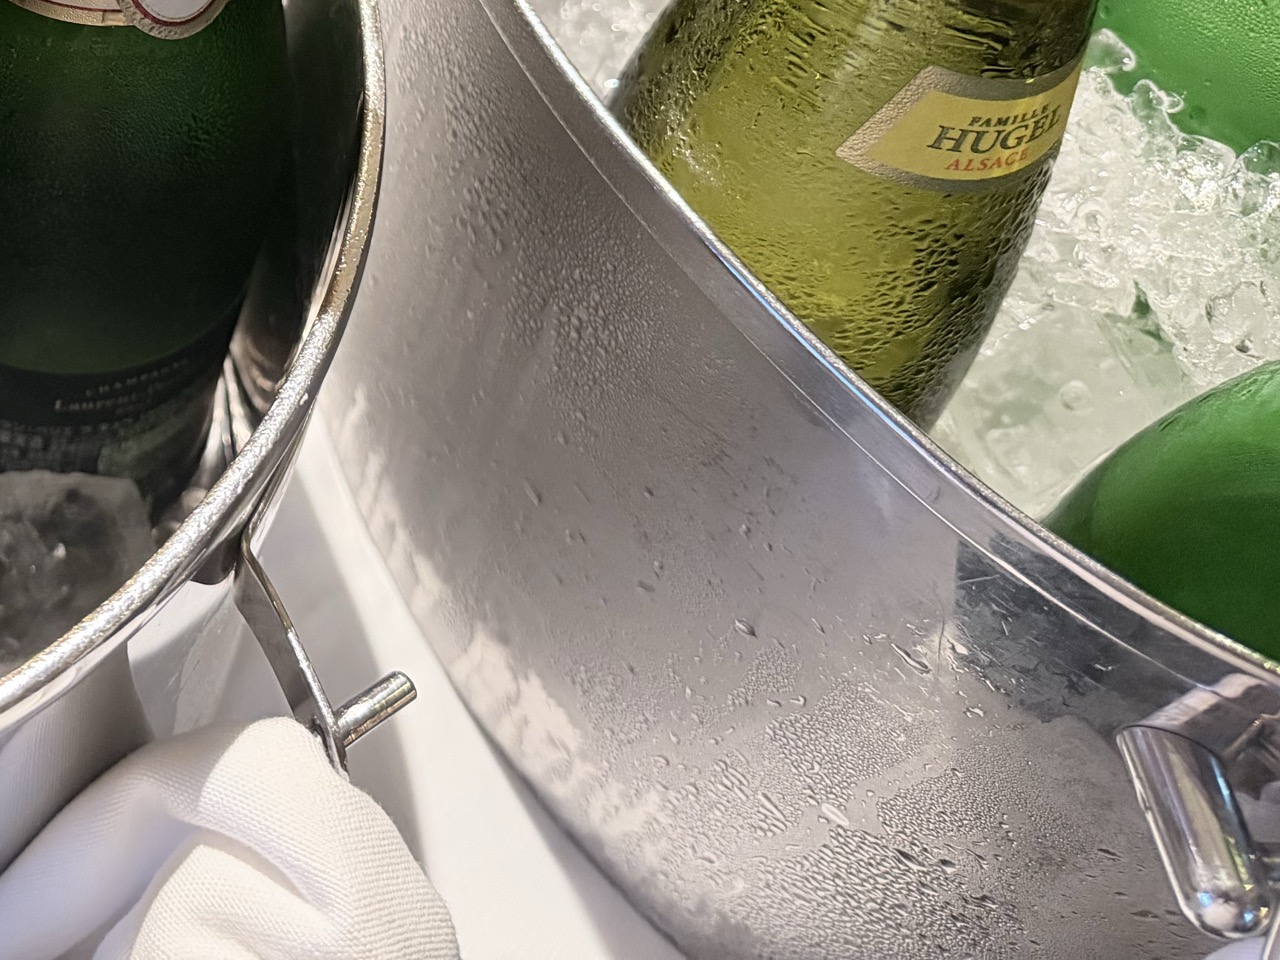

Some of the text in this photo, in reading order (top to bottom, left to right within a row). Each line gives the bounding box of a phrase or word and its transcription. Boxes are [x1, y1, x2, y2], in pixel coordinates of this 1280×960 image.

[968, 103, 1049, 127] FAMILLE
[926, 105, 1062, 154] HUGEL
[944, 148, 1029, 172] ALSACE
